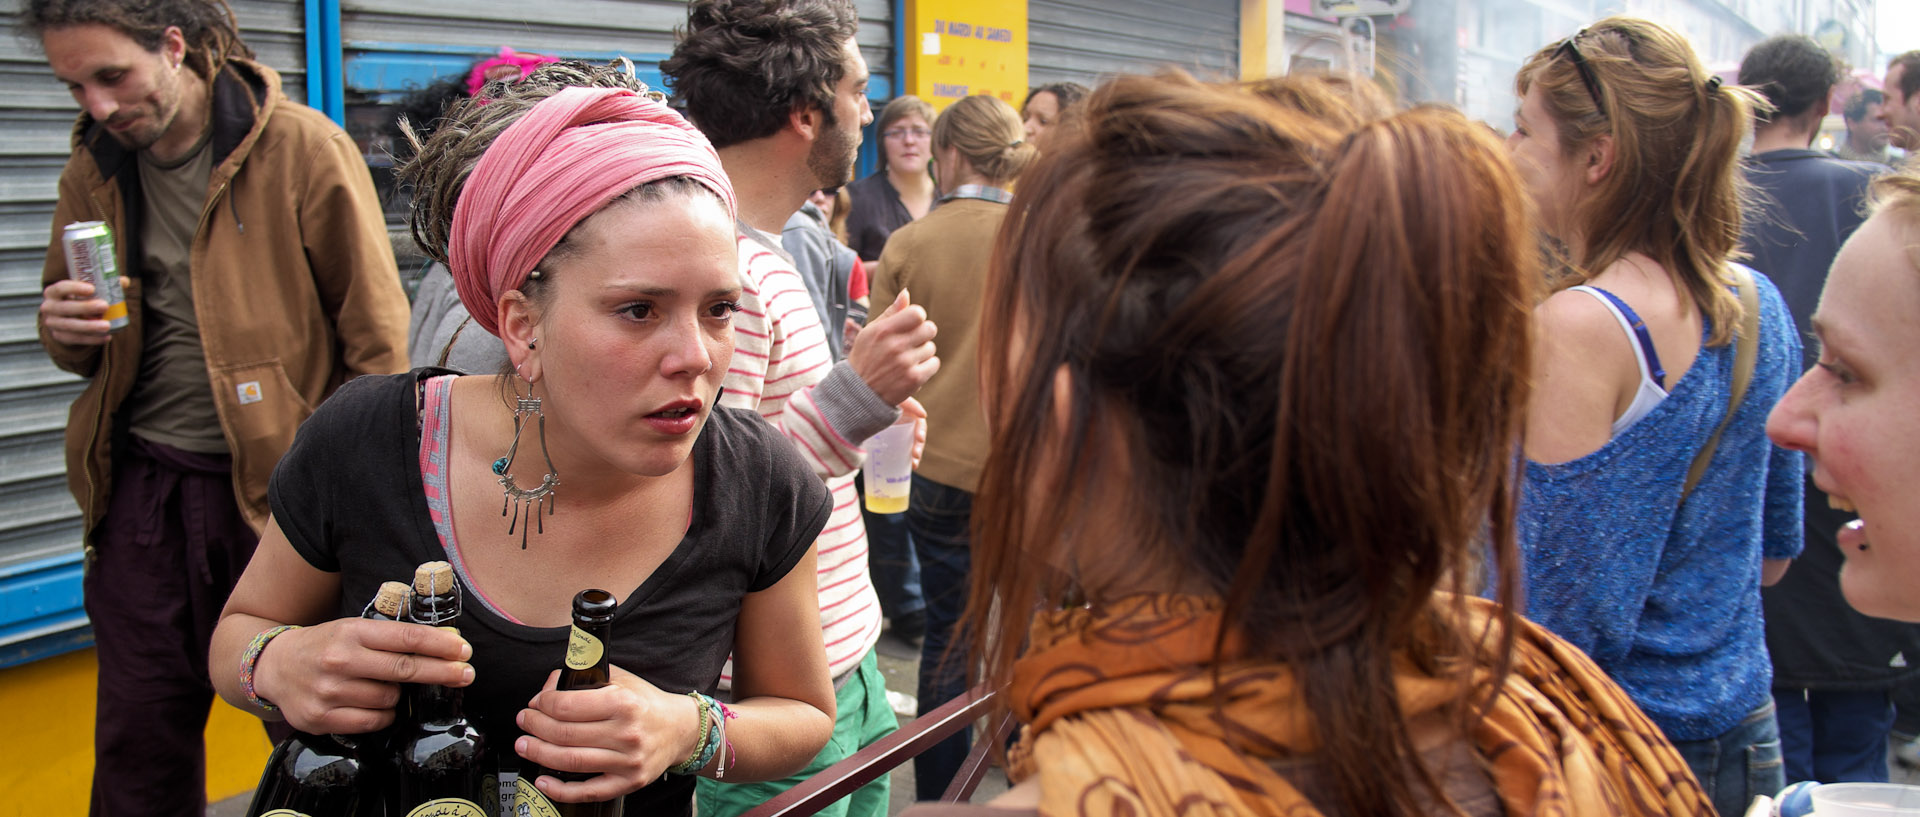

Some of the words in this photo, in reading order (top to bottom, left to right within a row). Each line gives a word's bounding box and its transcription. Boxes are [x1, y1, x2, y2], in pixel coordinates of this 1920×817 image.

[948, 21, 972, 38] MARDI
[986, 27, 1012, 43] SAMEDI
[933, 83, 969, 97] DIMANCHE
